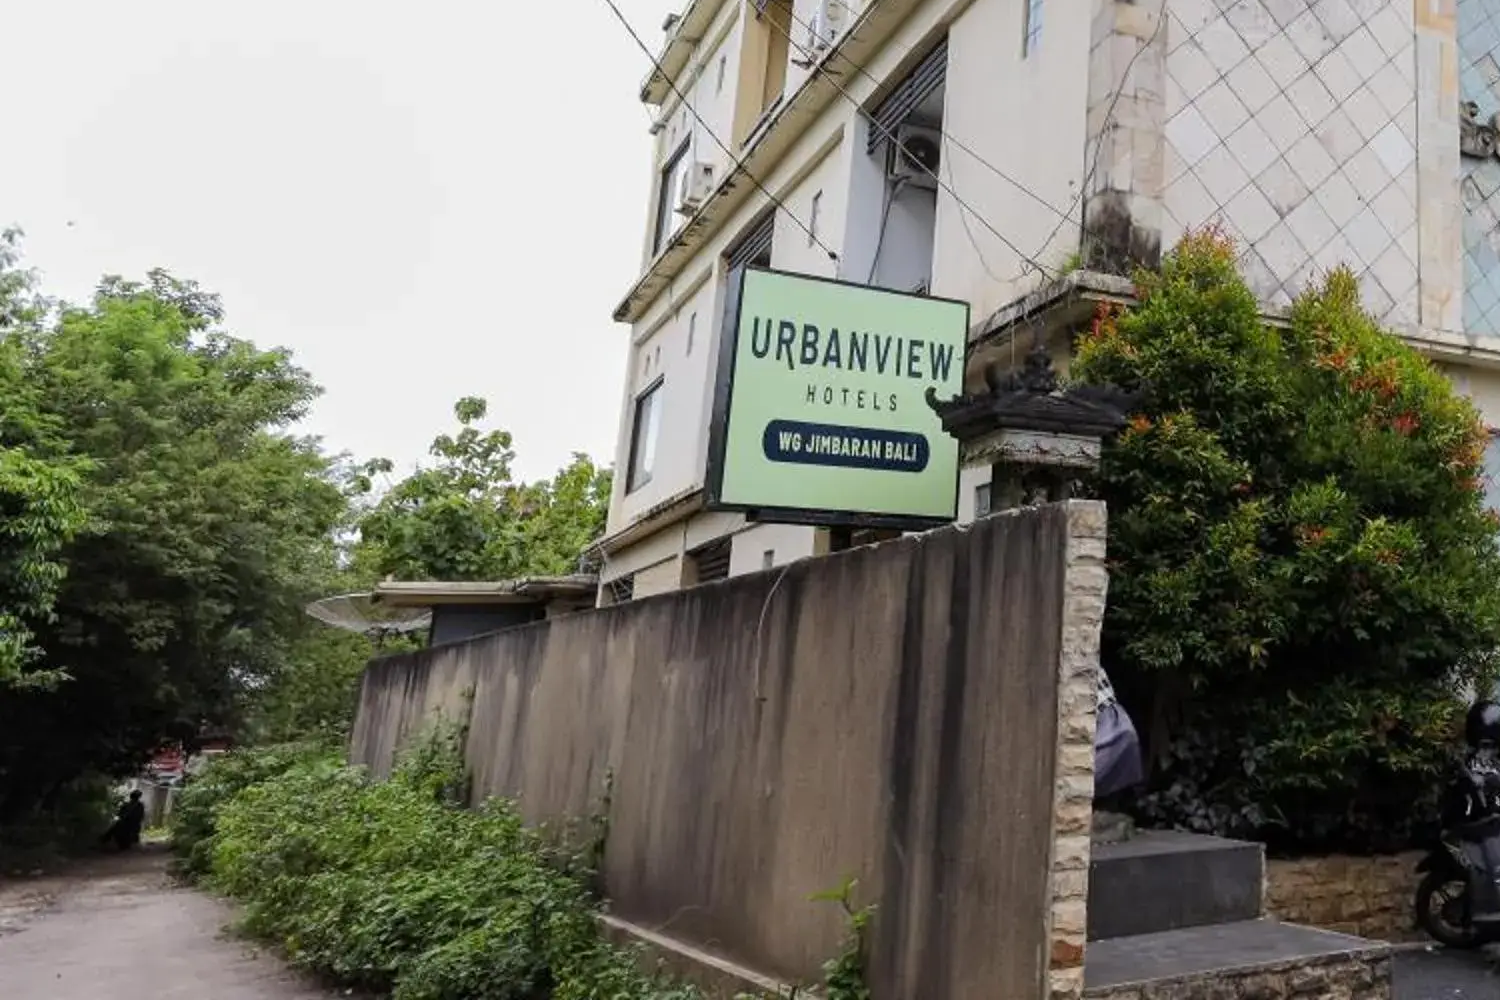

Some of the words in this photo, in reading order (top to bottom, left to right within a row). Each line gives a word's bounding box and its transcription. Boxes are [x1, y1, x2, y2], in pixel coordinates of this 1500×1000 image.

[751, 316, 954, 382] URBANVIEW
[806, 384, 898, 412] HOTELS
[778, 430, 801, 452] WG
[805, 433, 881, 459] JIMBARAN
[884, 440, 918, 462] BALI
